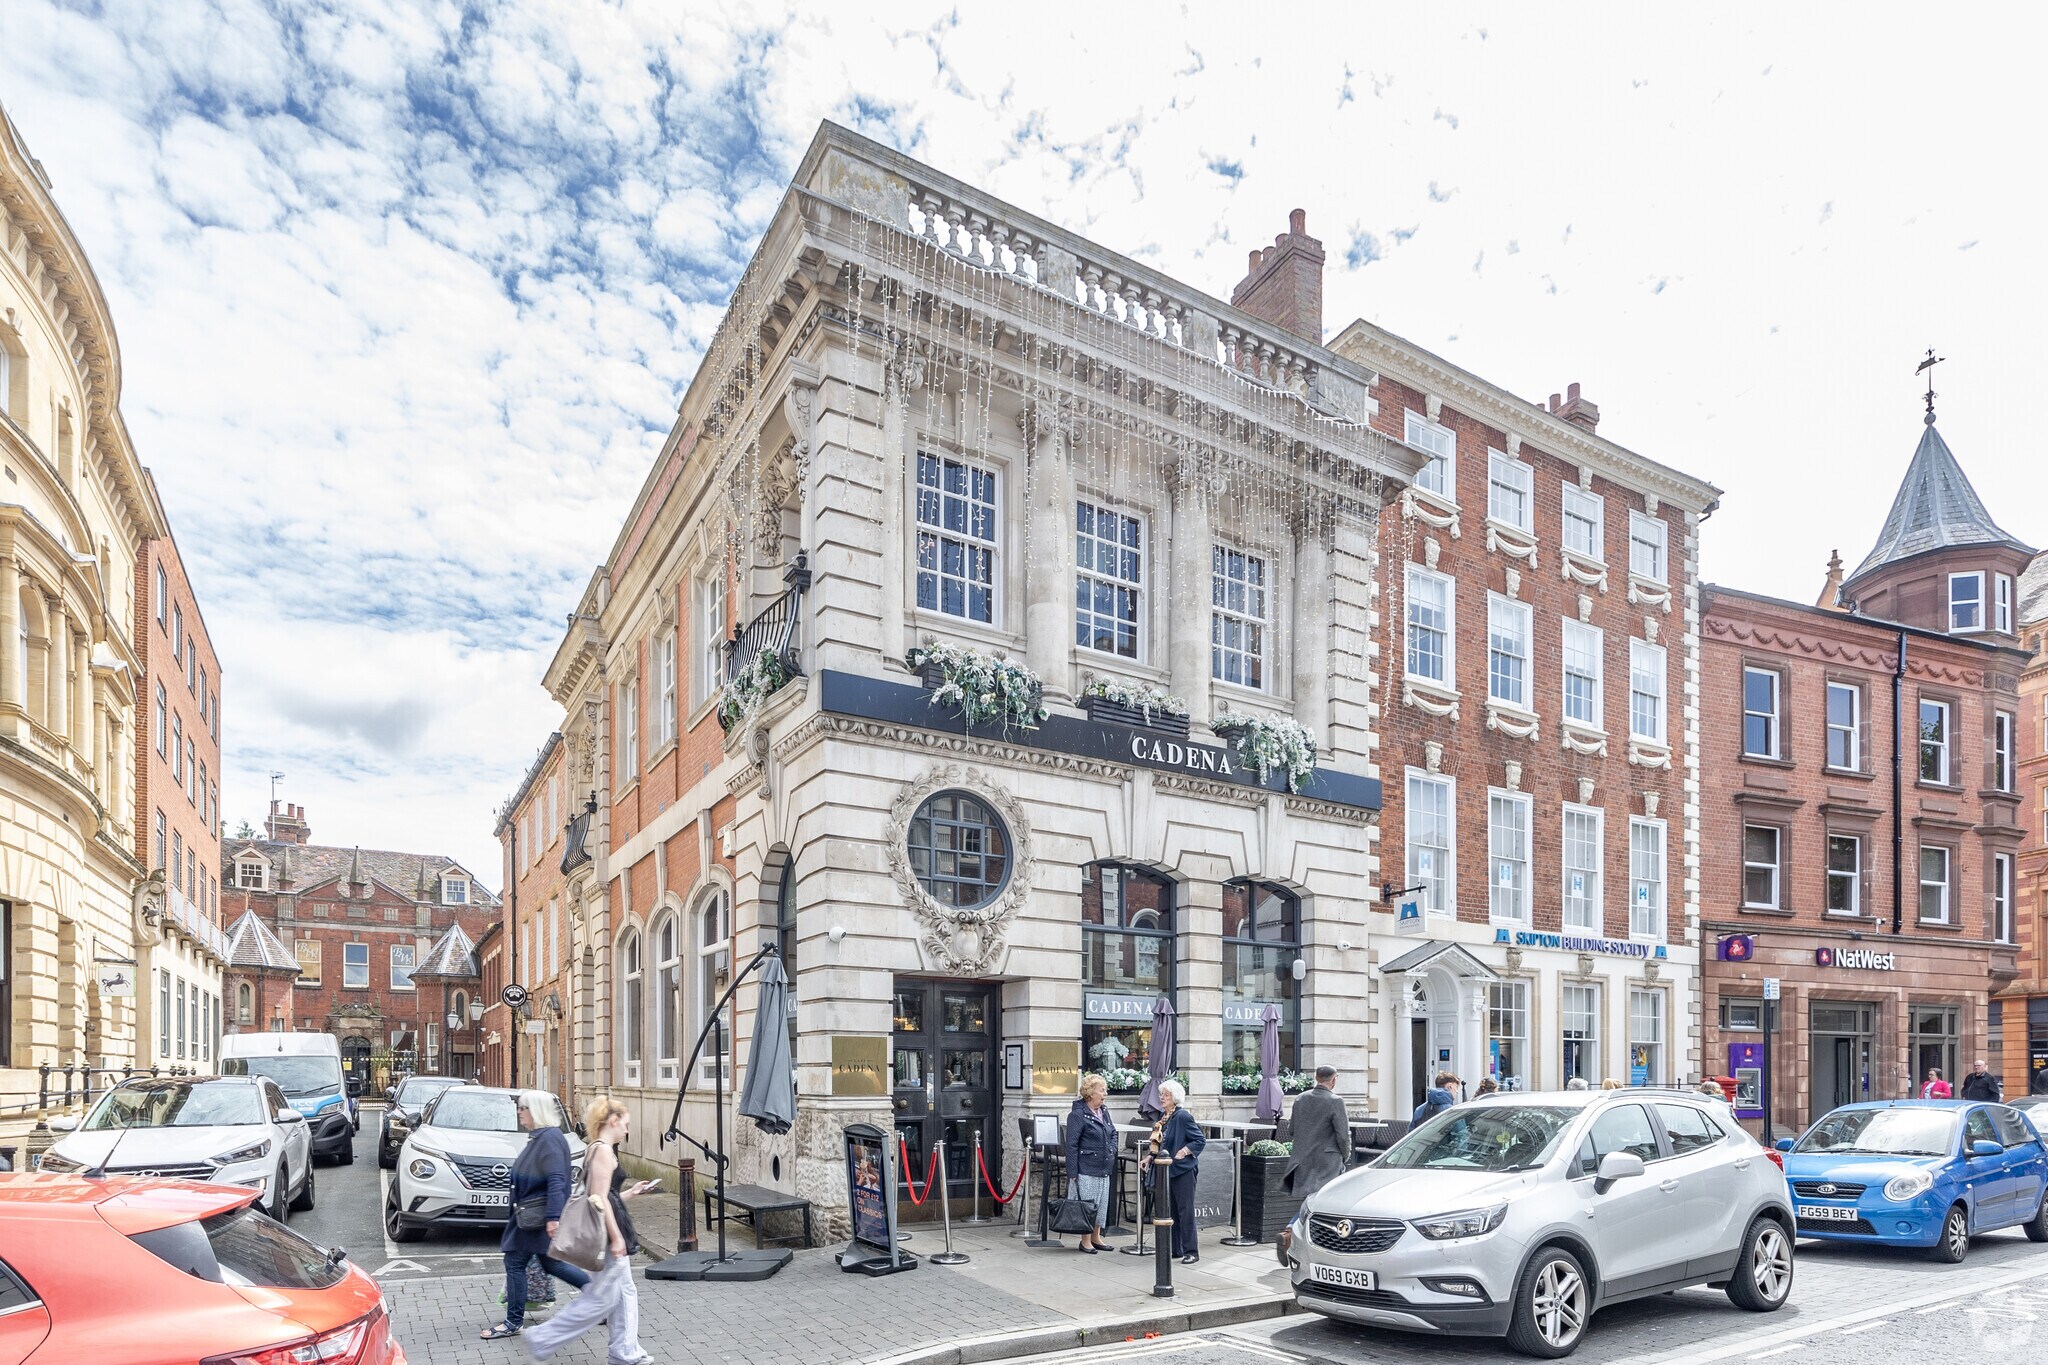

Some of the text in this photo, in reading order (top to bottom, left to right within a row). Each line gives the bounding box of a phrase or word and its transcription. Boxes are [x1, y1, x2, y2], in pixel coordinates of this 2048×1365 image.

[1131, 736, 1233, 775] CADENA
[1515, 931, 1650, 959] SKIPTON BUILDING SOCIETY
[1835, 947, 1896, 970] NatWest
[1088, 999, 1153, 1015] CADENA
[1225, 1006, 1281, 1022] CADE
[839, 1064, 880, 1072] CADENA
[471, 1194, 500, 1204] DL23
[1194, 1205, 1221, 1217] DENA
[1800, 1206, 1855, 1219] FG59 BEY
[1345, 1271, 1369, 1287] GXB
